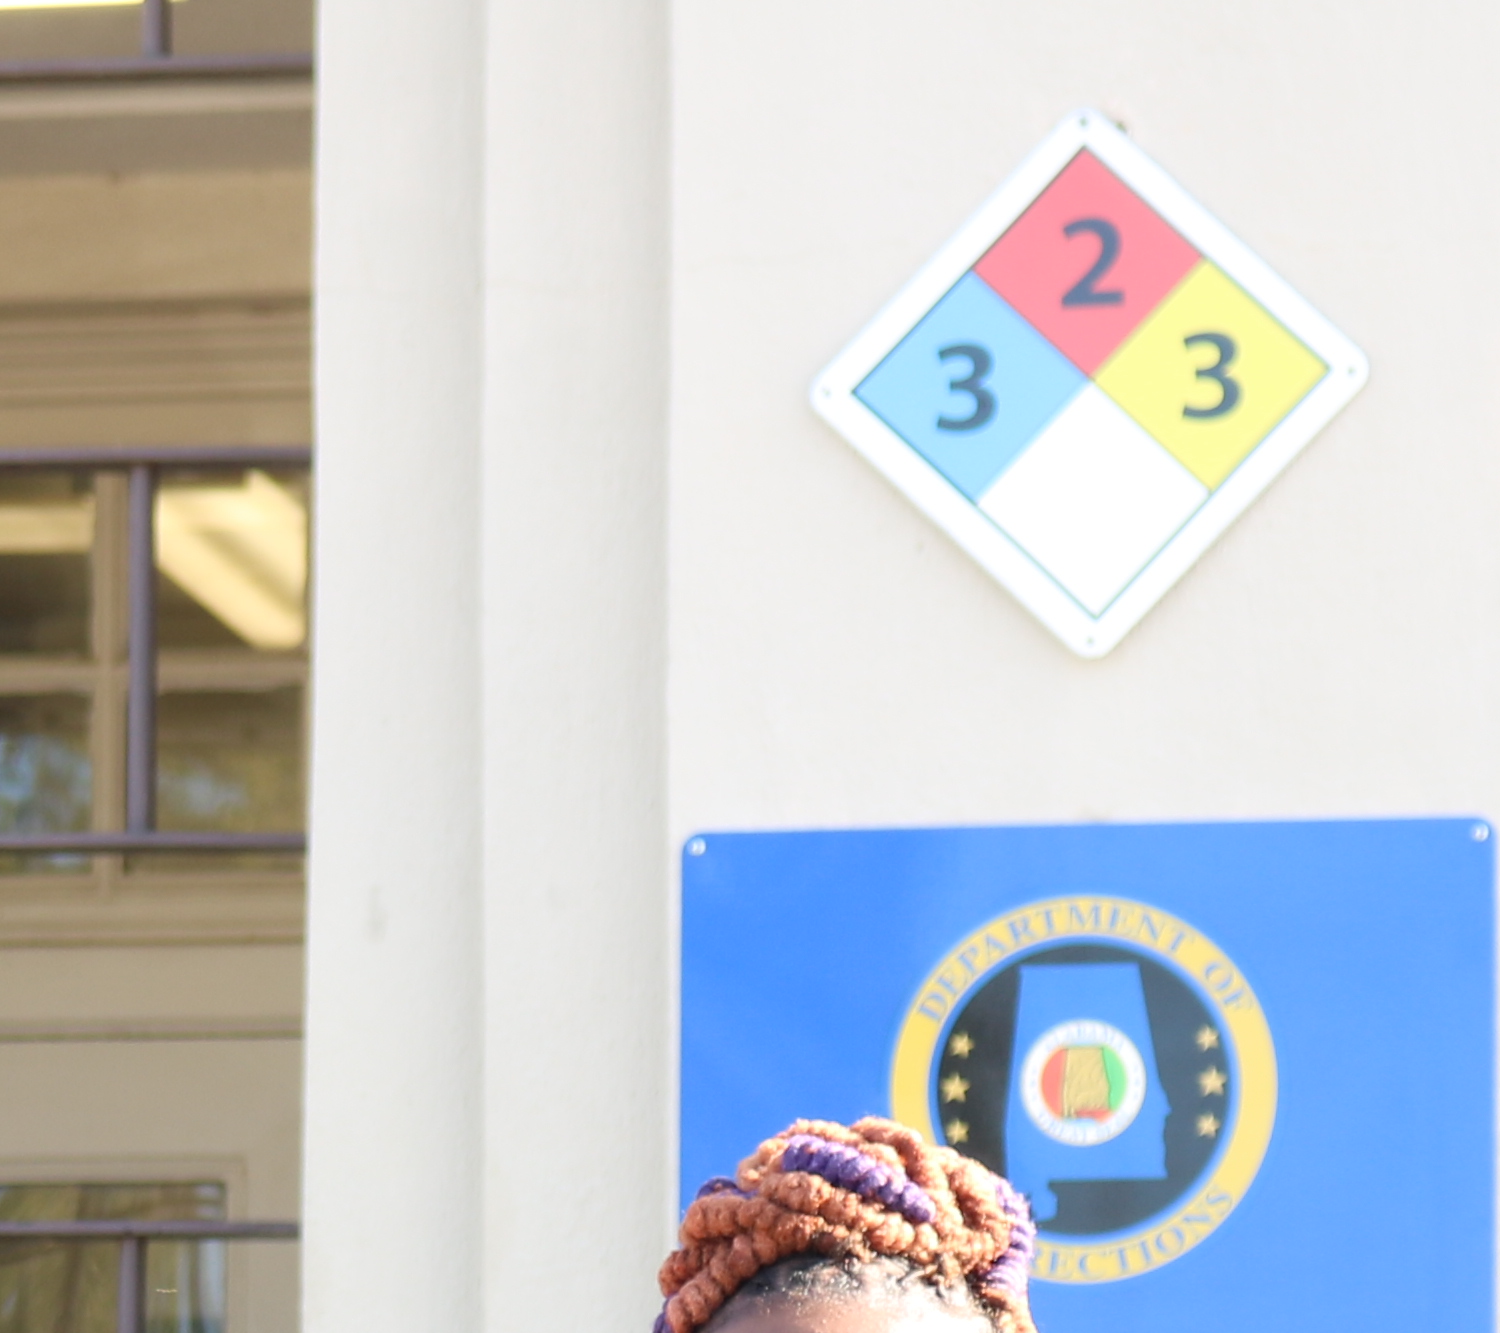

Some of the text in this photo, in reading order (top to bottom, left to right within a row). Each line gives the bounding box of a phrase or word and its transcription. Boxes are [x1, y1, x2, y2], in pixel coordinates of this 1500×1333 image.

[1060, 217, 1125, 309] 2
[937, 331, 1243, 432] 3 3
[916, 904, 1253, 1022] DEPARTMENT OF
[1030, 1185, 1234, 1280] RECTIONS
